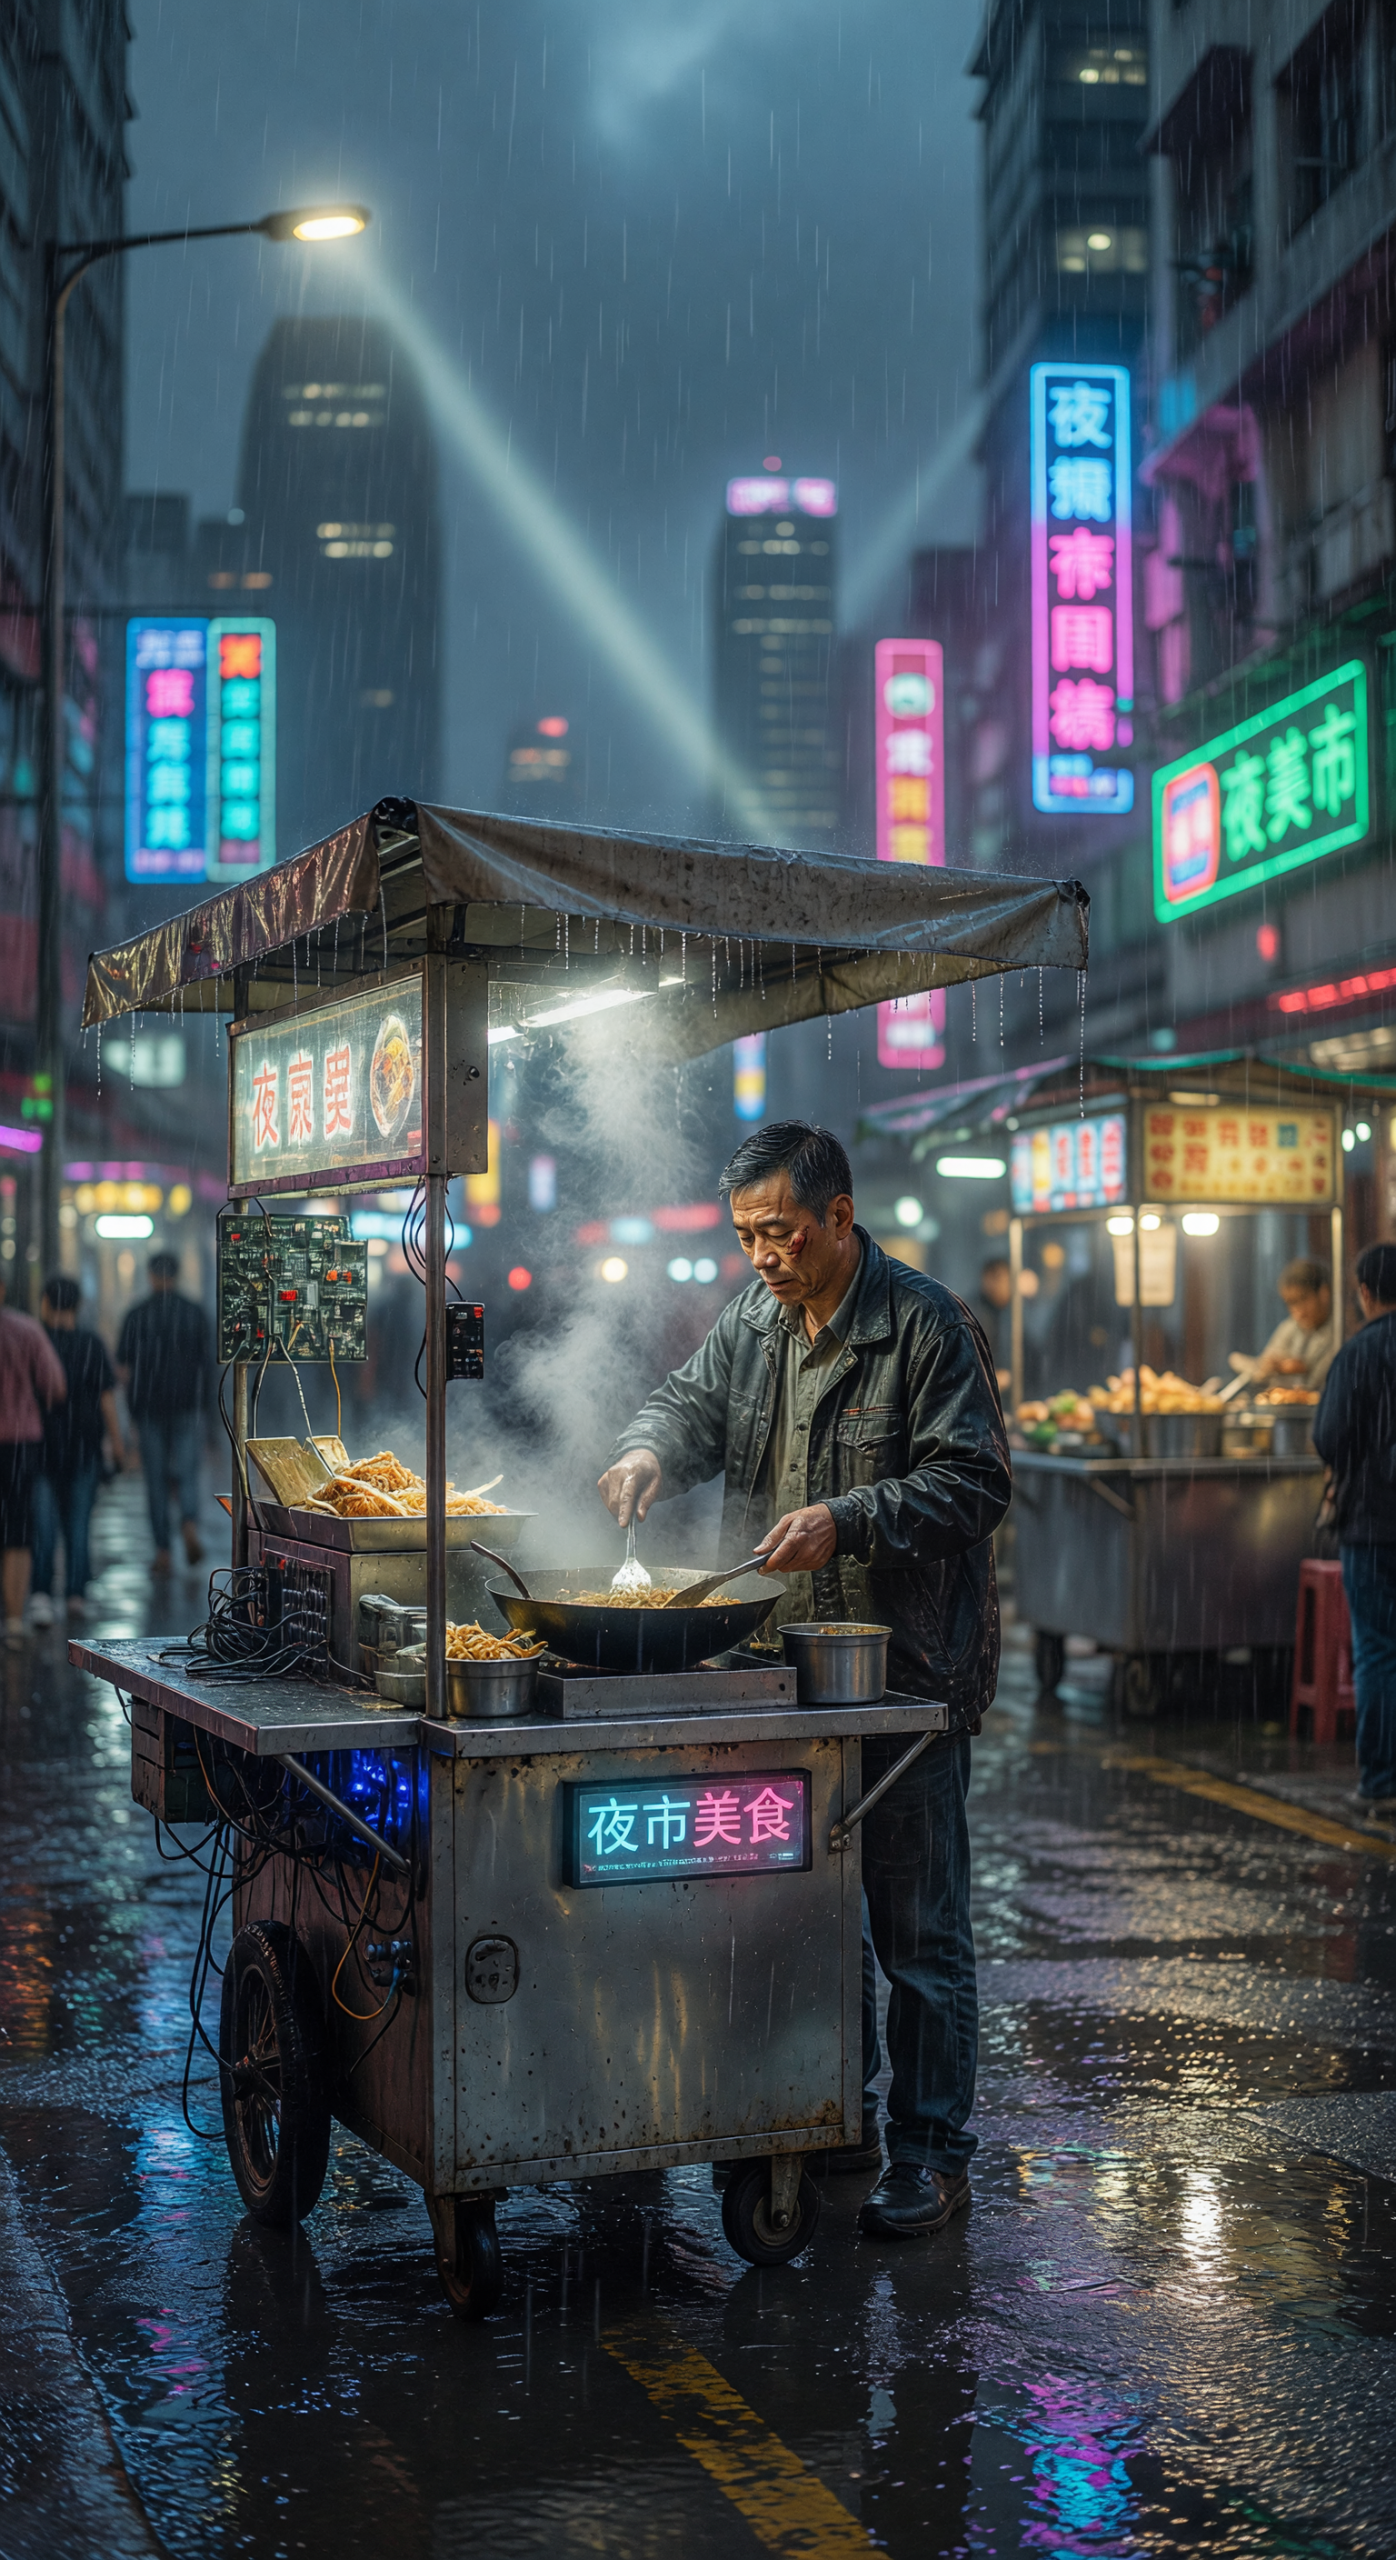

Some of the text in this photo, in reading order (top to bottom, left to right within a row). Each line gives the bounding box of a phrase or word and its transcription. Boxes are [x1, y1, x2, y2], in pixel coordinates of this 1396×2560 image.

[1220, 703, 1357, 862] 夜美市
[587, 1786, 795, 1856] 夜市美食
